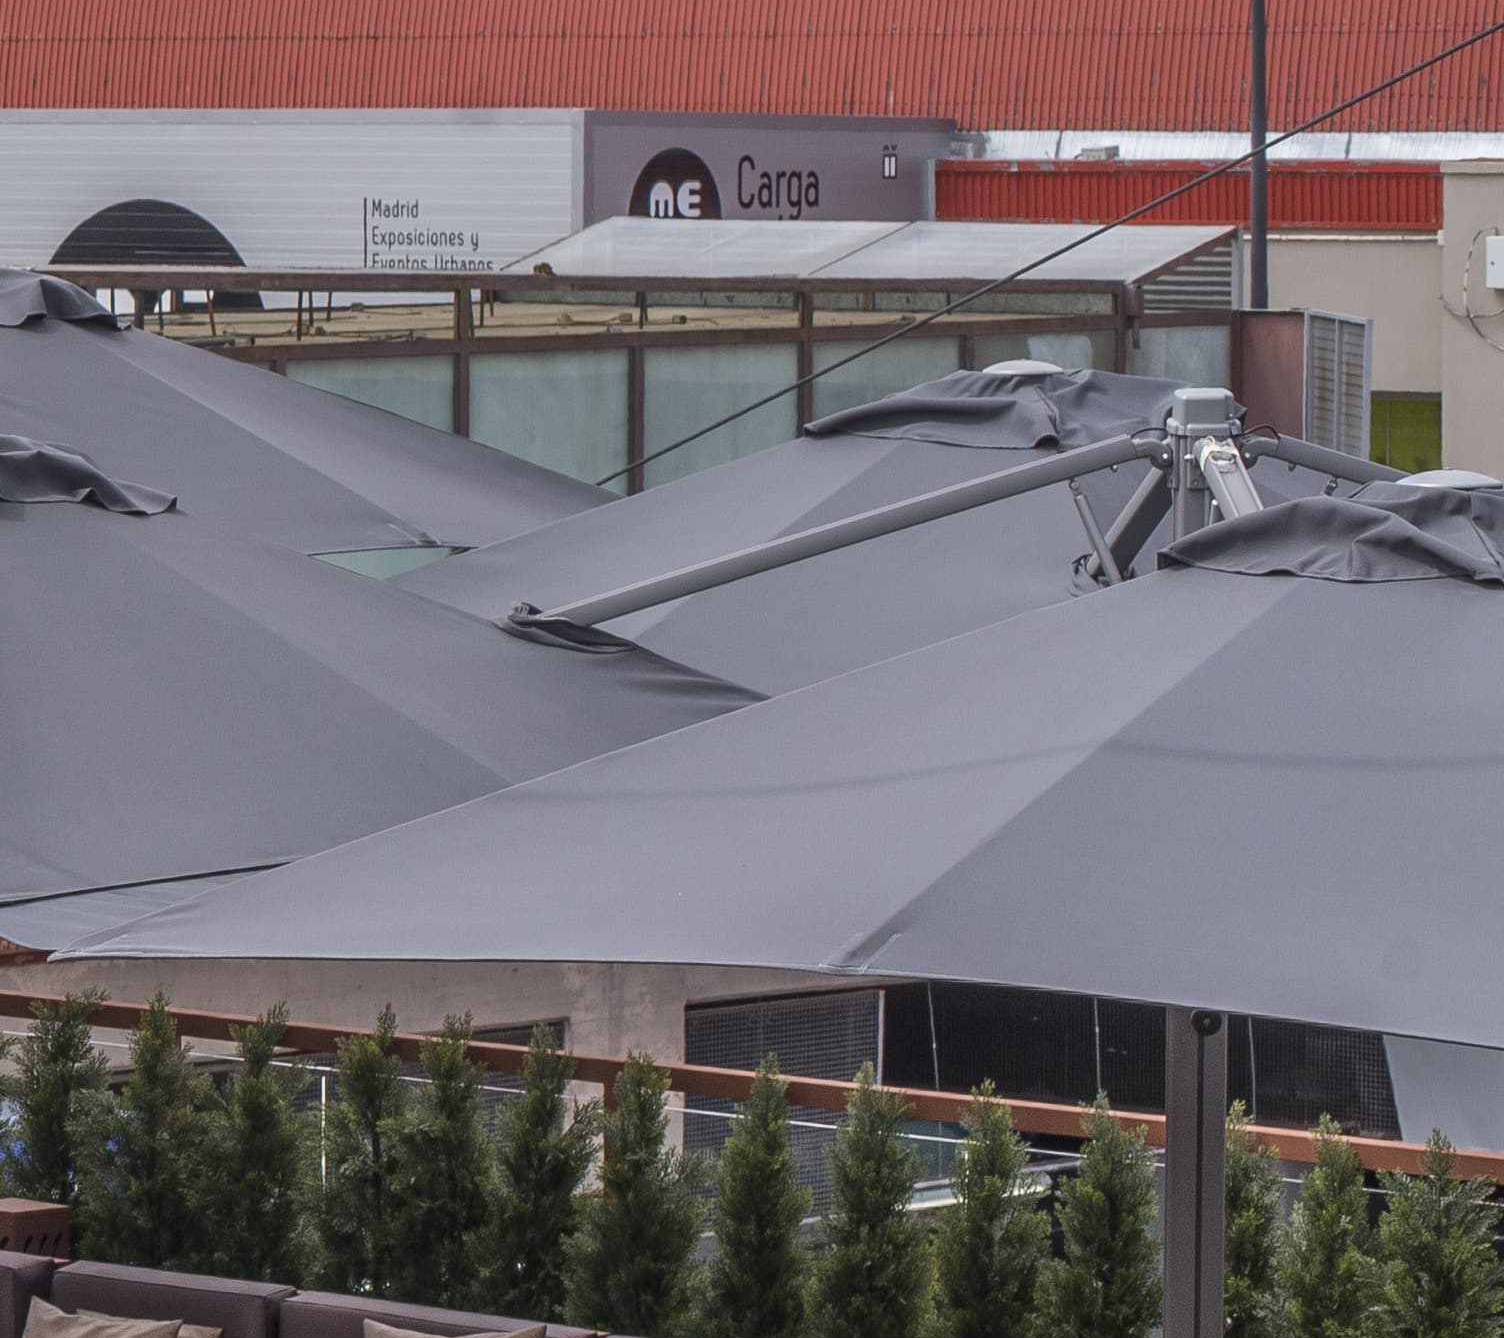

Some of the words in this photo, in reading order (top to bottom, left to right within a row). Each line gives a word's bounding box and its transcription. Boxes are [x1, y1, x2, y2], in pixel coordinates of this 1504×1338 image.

[737, 154, 820, 221] Carga
[371, 199, 419, 220] Madrid
[371, 228, 465, 252] Exposiciones
[470, 231, 480, 253] y
